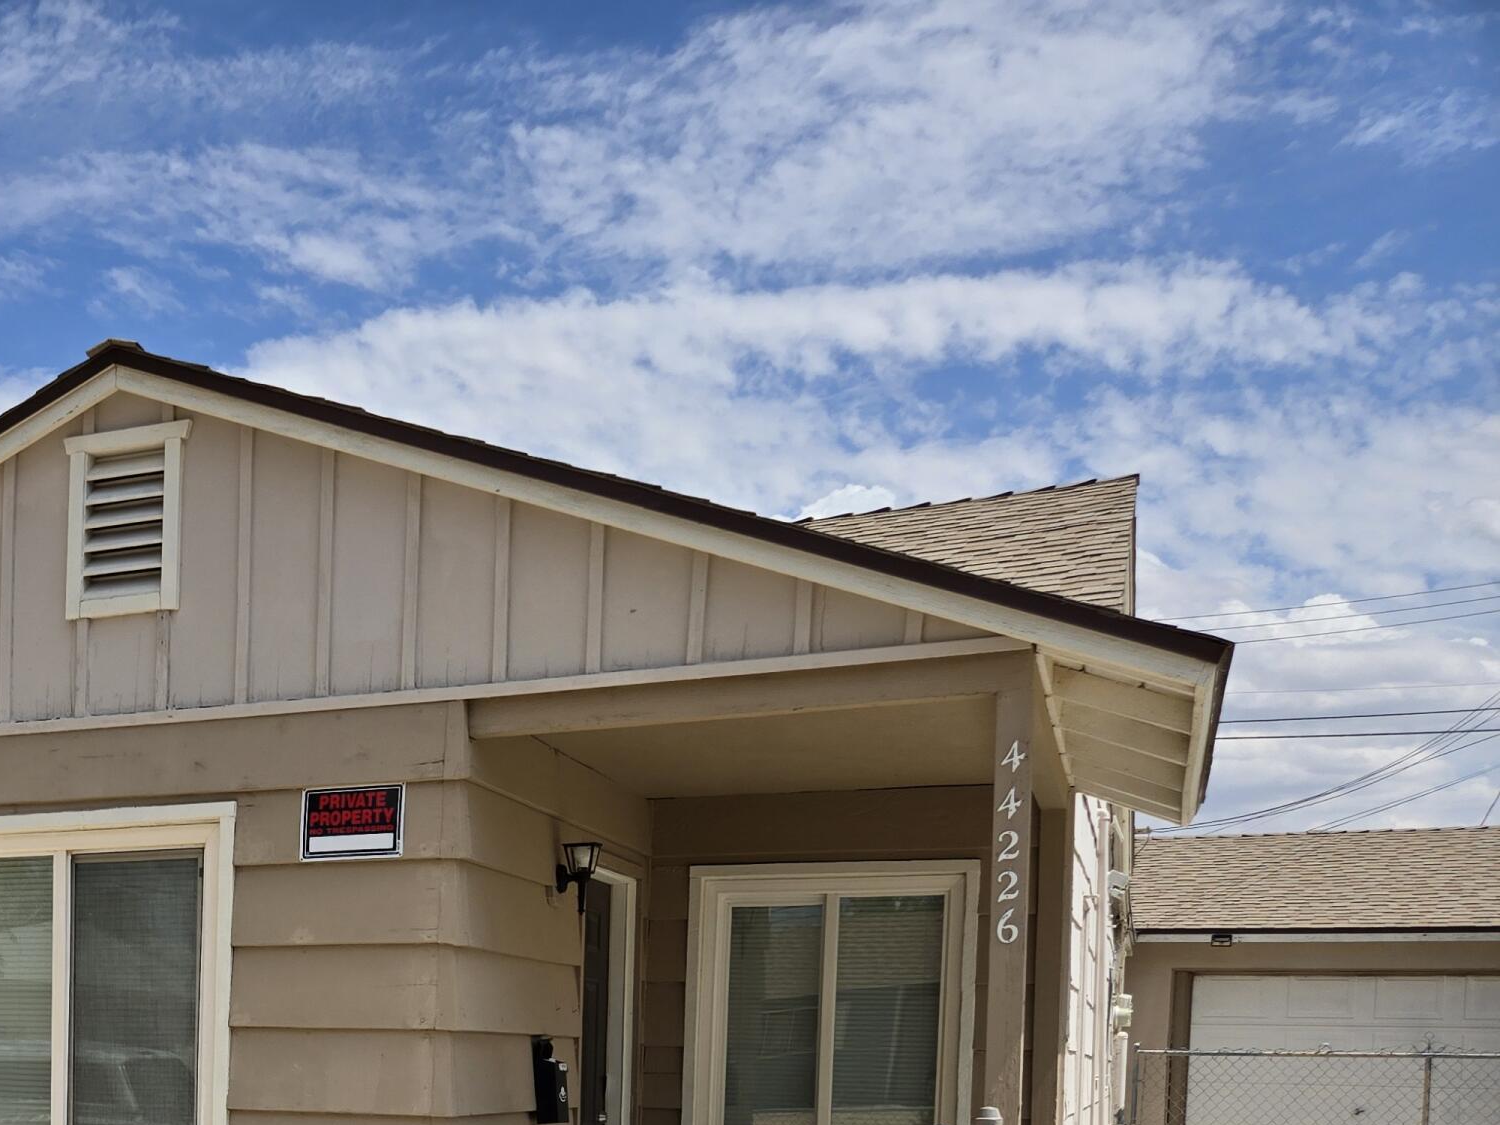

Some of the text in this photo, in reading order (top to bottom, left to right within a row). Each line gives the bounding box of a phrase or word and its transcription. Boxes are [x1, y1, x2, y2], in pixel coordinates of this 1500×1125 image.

[319, 791, 387, 809] PRIVATE
[309, 808, 395, 826] PROPERTY
[996, 739, 1027, 944] 44226
